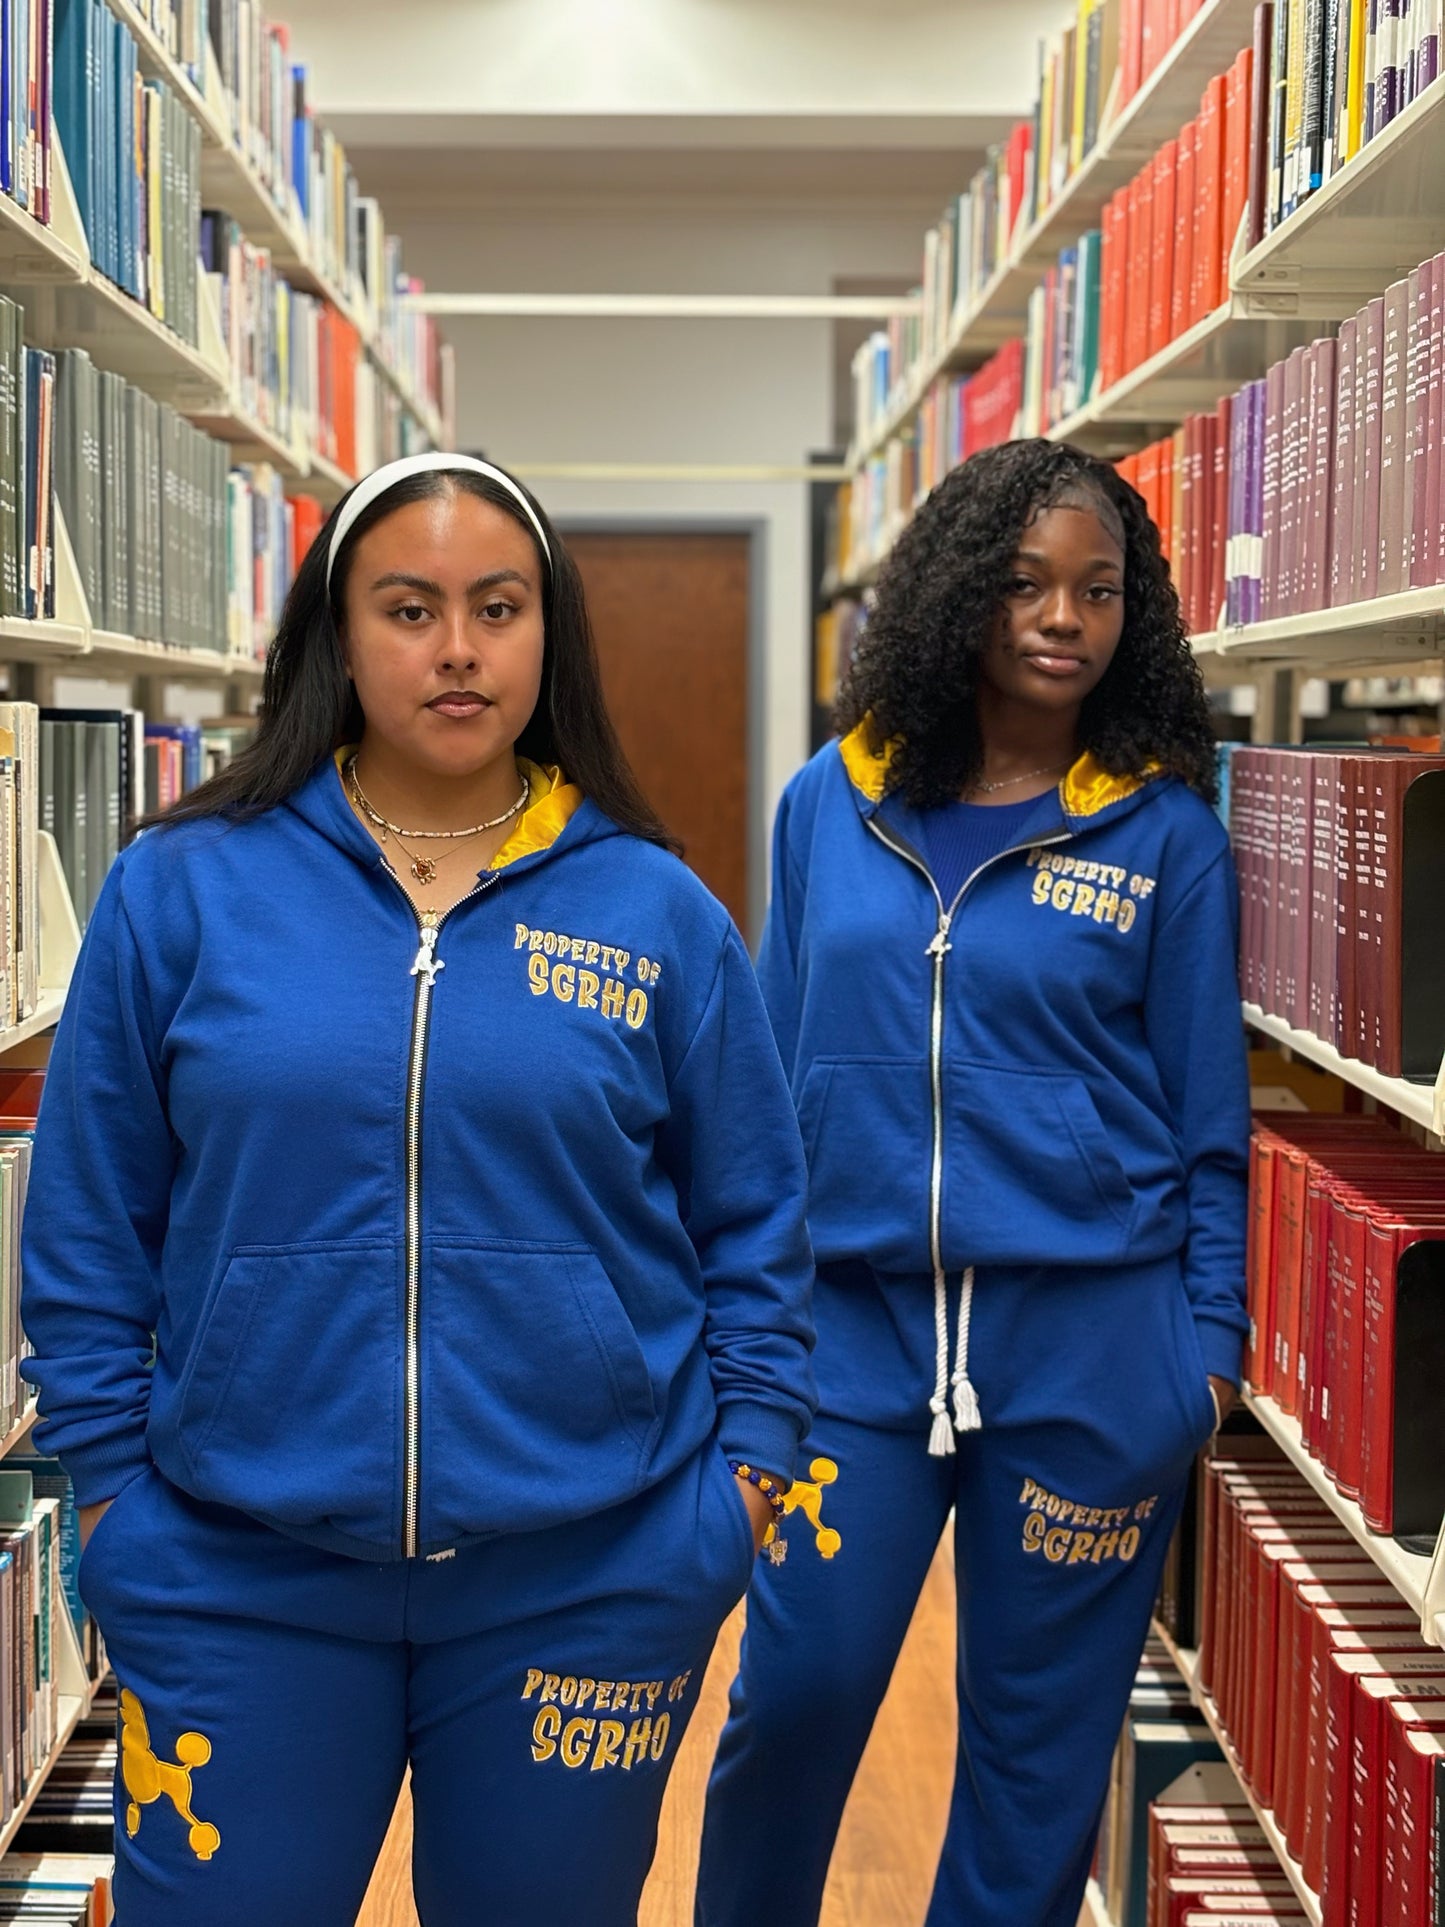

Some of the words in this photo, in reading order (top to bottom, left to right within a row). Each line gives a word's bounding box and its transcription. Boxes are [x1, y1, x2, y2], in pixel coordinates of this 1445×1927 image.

[1026, 847, 1127, 889] PROPERTY
[1129, 874, 1156, 899] OF
[1031, 870, 1136, 933] SGRHO
[514, 923, 630, 976] PROPERTY
[637, 957, 661, 986] OF
[528, 952, 648, 1029] SGRHO
[1019, 1477, 1130, 1527] PROPERTY
[1134, 1495, 1158, 1520] OF
[1022, 1511, 1141, 1565] SGRHO
[521, 1668, 664, 1713] PROPERTY
[668, 1669, 692, 1702] OF
[531, 1704, 671, 1772] SGRHO
